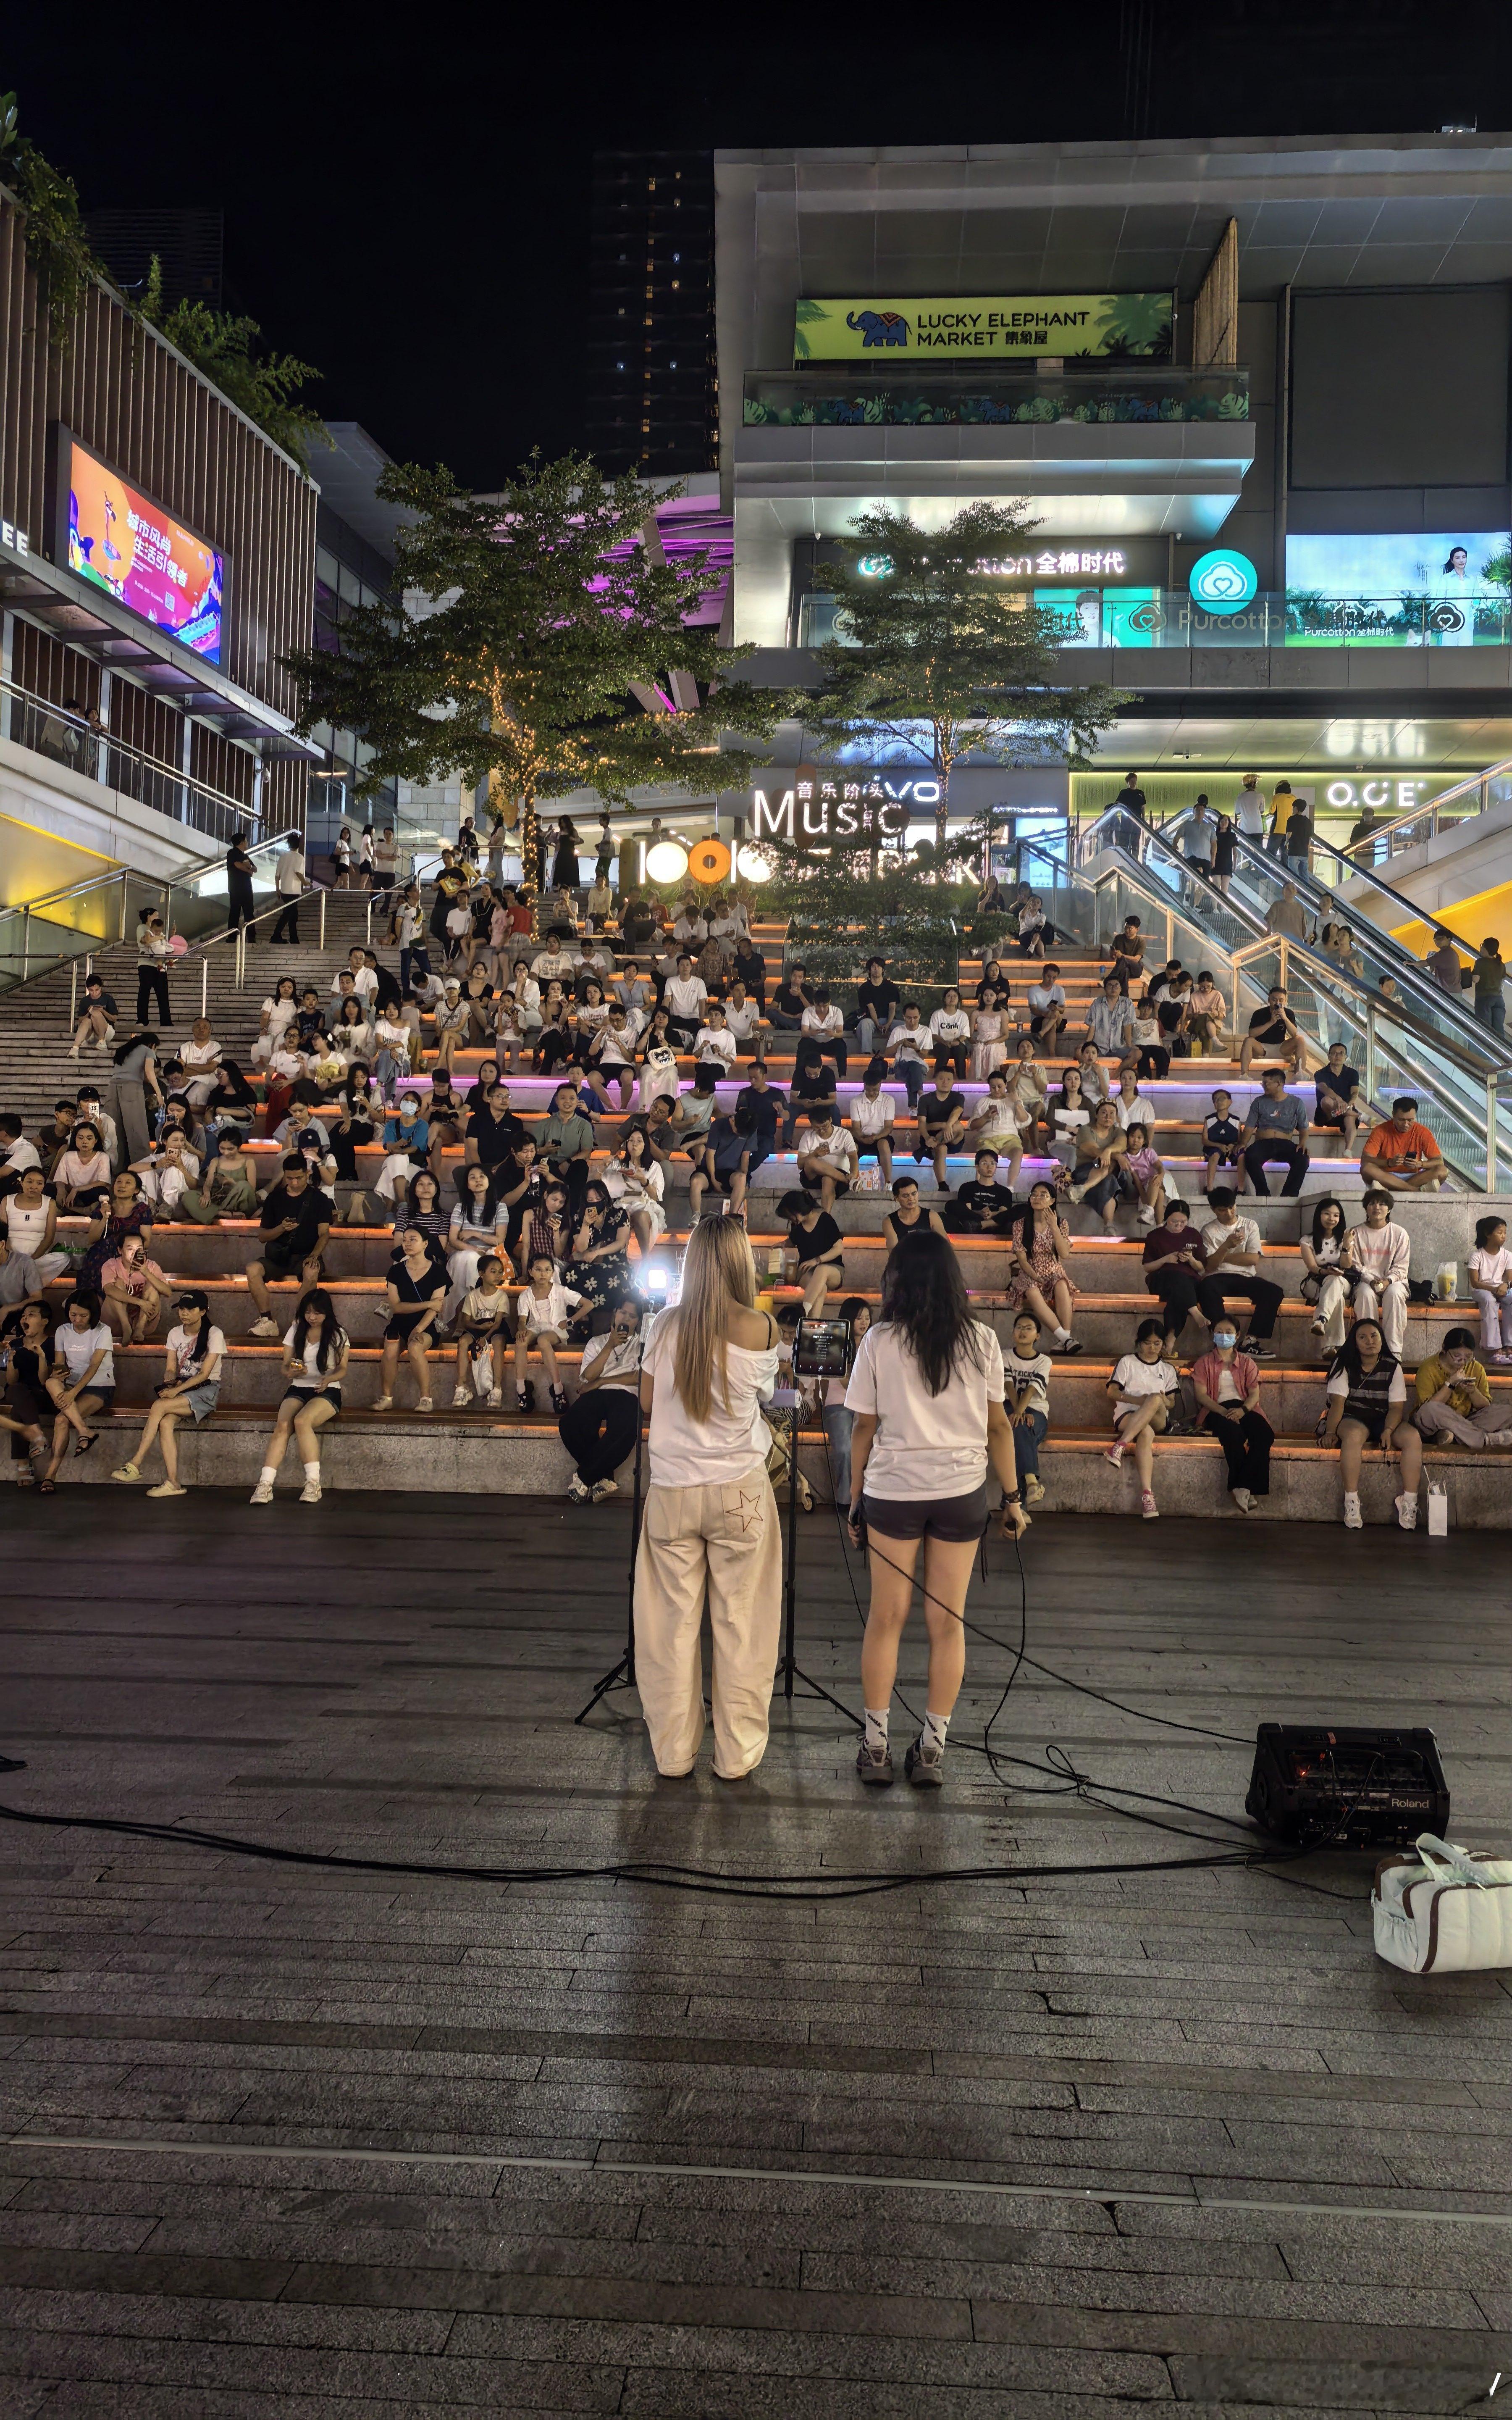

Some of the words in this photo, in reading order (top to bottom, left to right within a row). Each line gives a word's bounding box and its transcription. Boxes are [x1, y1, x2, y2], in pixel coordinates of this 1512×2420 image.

[917, 313, 982, 328] LUCKY
[988, 312, 1090, 327] ELEPHANT
[917, 331, 998, 346] MARKET
[127, 509, 171, 555] 城市风尚
[133, 534, 188, 587] 生活引领者
[1036, 552, 1124, 574] 全棉时代
[1179, 609, 1297, 631] Purcotton
[1305, 626, 1356, 637] Purcotton
[1391, 1798, 1429, 1809] Roland
